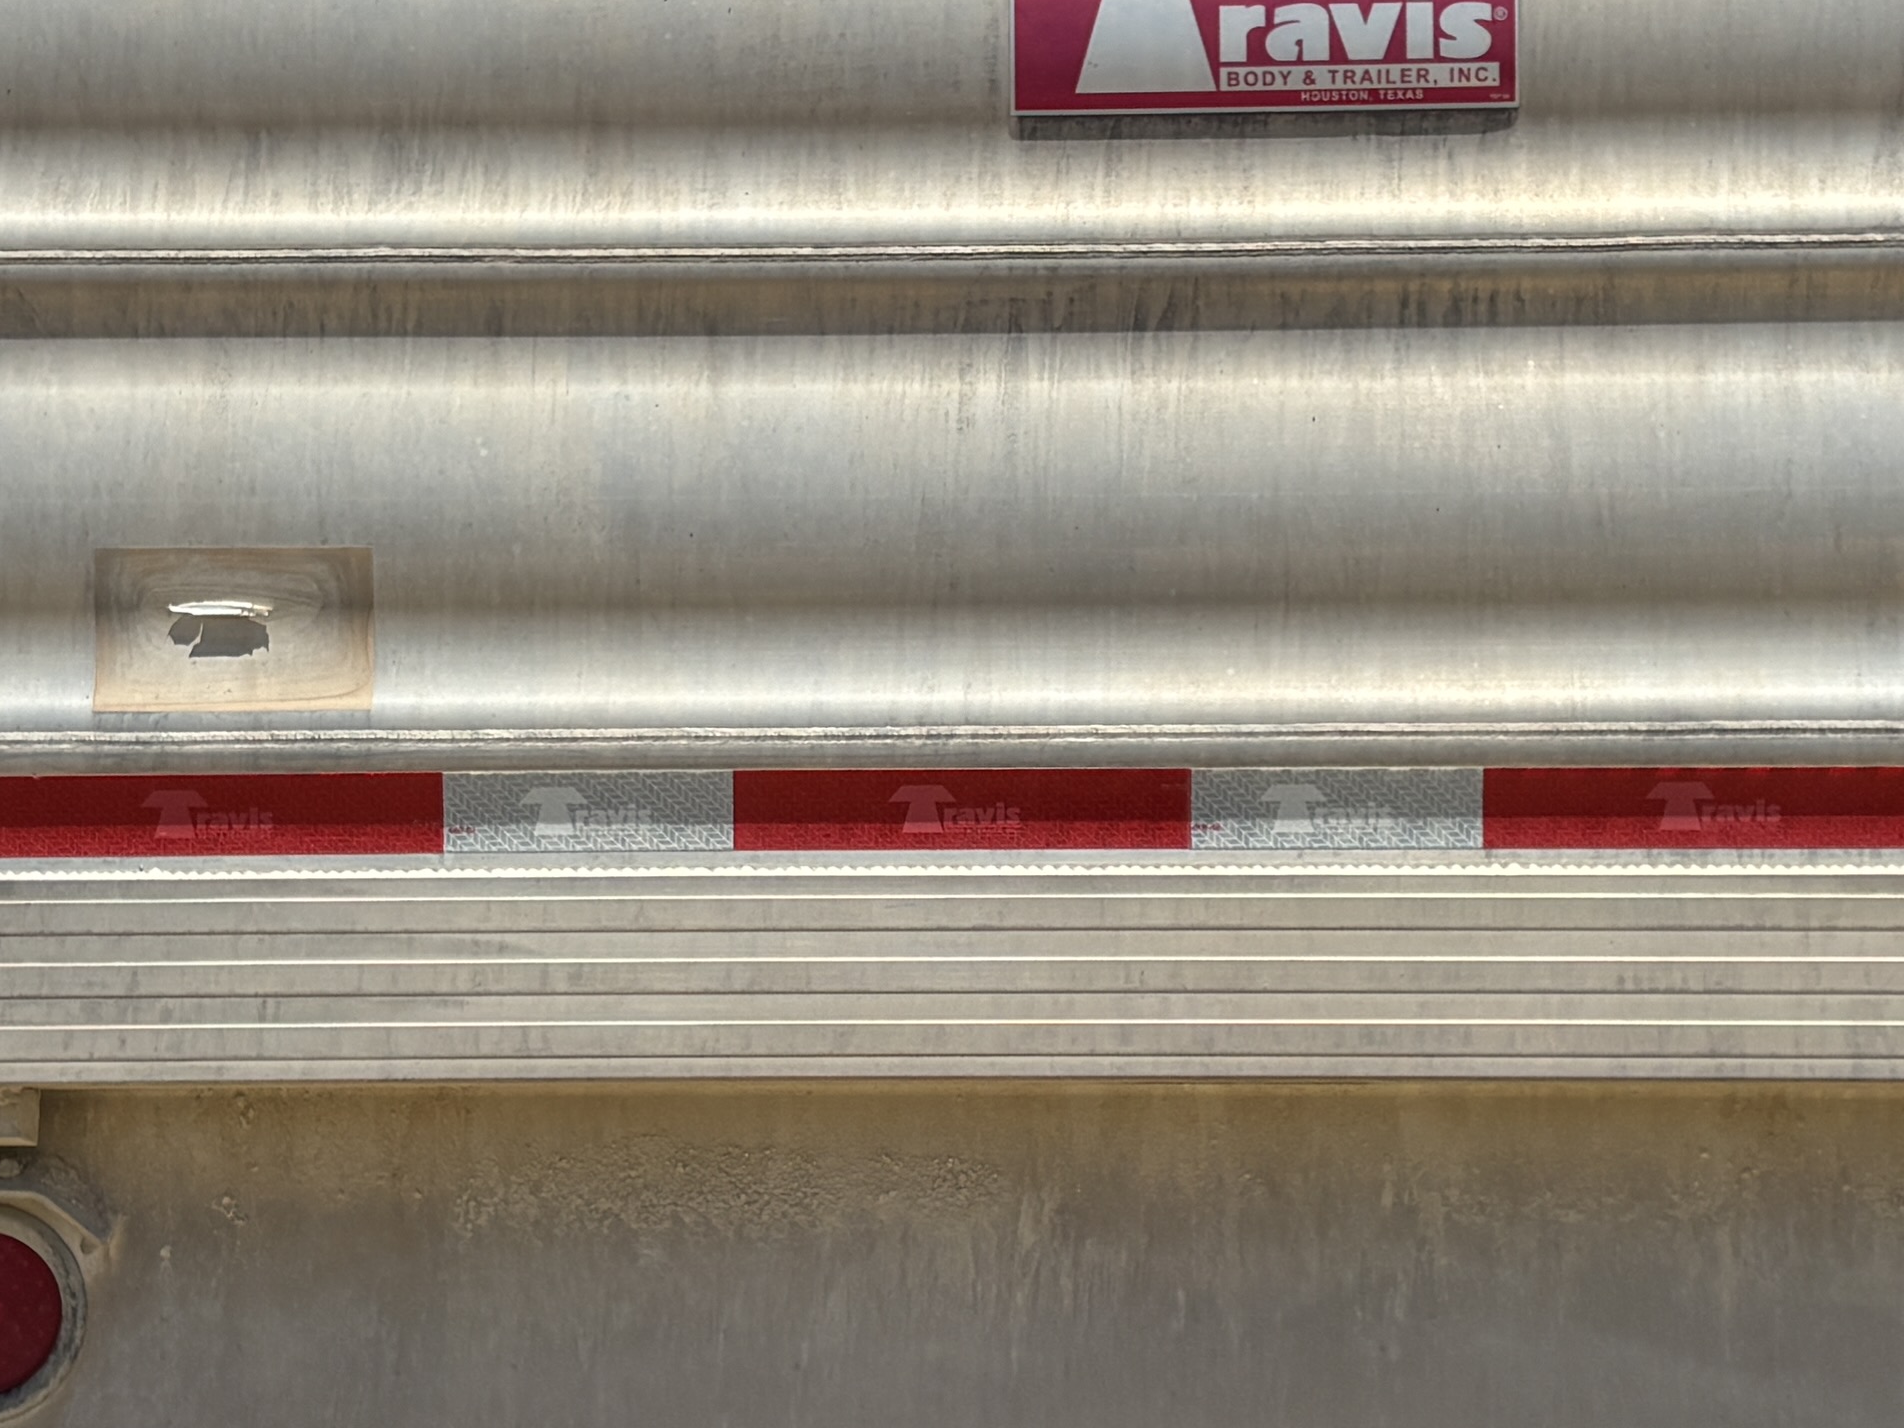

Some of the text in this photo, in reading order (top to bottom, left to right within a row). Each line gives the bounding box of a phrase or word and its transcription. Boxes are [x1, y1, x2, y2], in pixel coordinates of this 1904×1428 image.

[1226, 66, 1497, 88] BODY & TRAILER, INC.
[1379, 88, 1424, 101] TEXAS
[139, 789, 274, 839] Travis
[888, 784, 1022, 834] Travis
[1645, 780, 1782, 831] Travis
